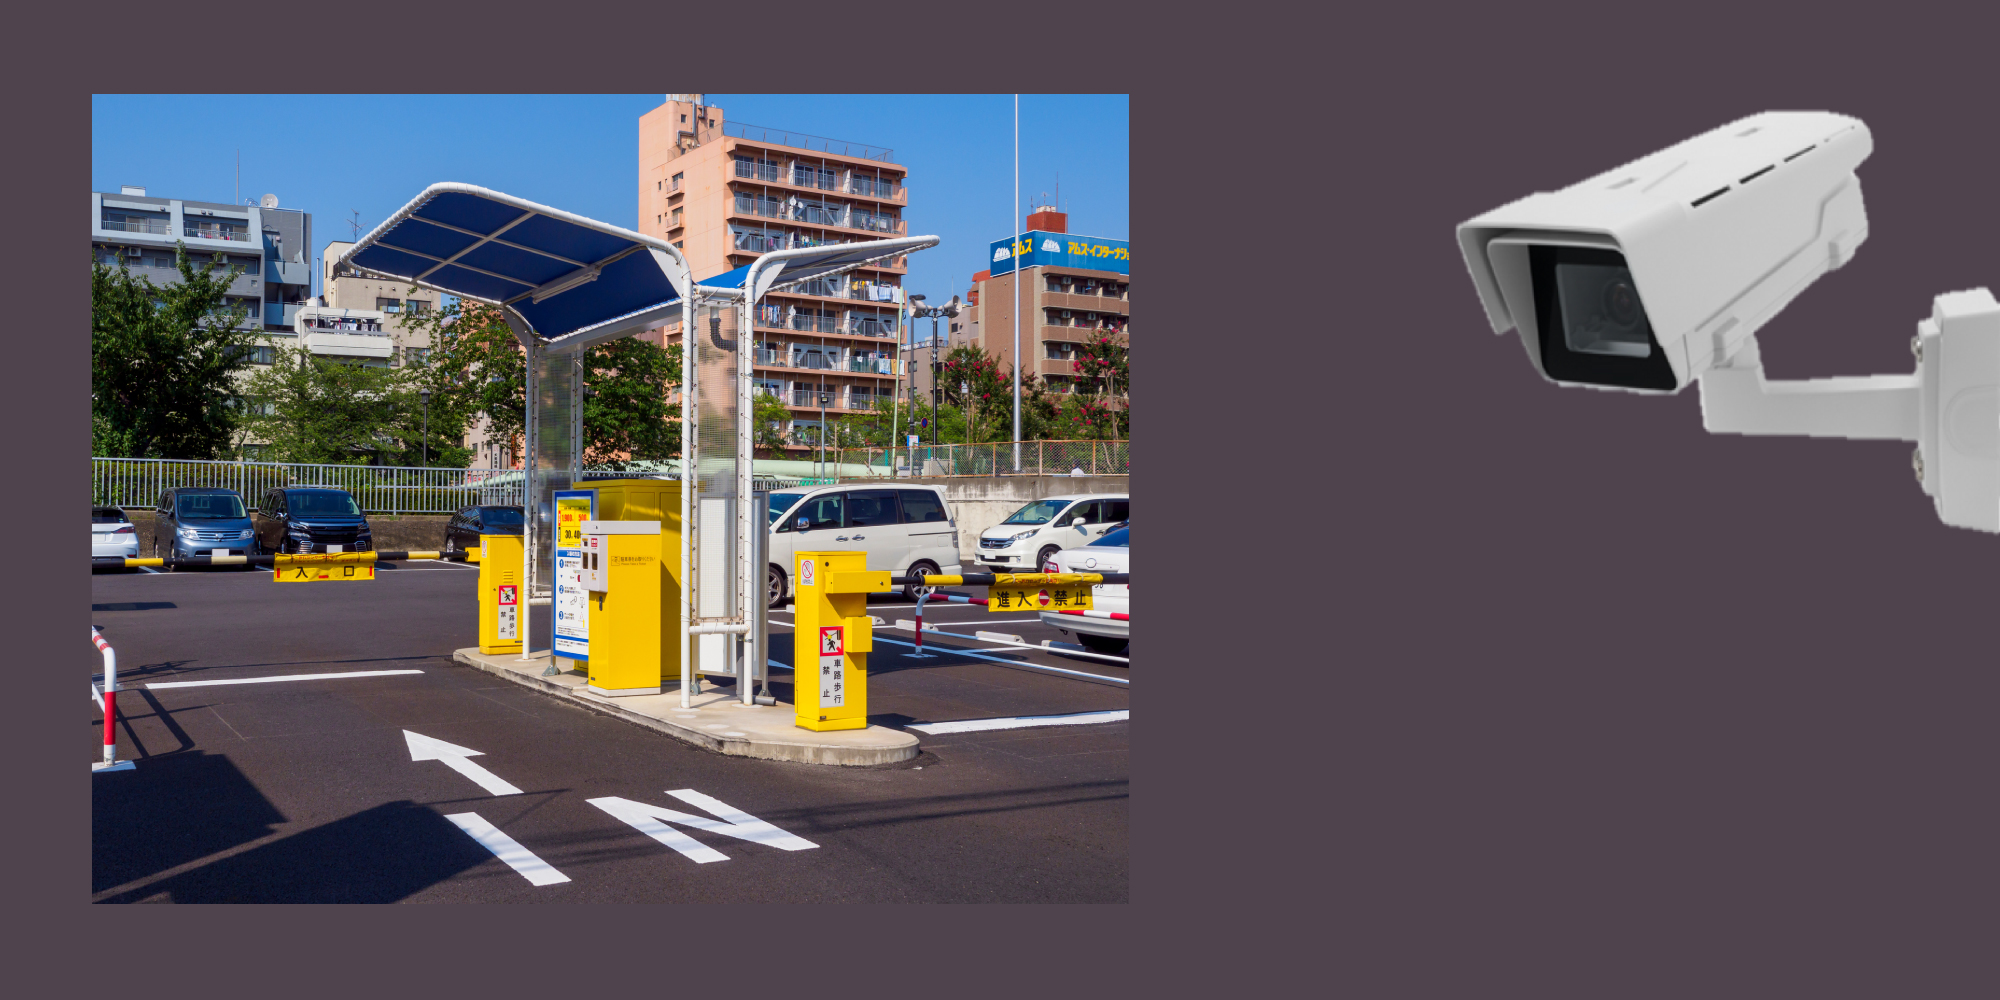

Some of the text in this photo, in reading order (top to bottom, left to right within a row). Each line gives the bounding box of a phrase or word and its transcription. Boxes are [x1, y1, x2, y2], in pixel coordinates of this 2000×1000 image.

[295, 565, 355, 579] 入口
[822, 666, 831, 698] 禁止
[833, 658, 842, 704] 車路歩行
[444, 788, 820, 886] IN
